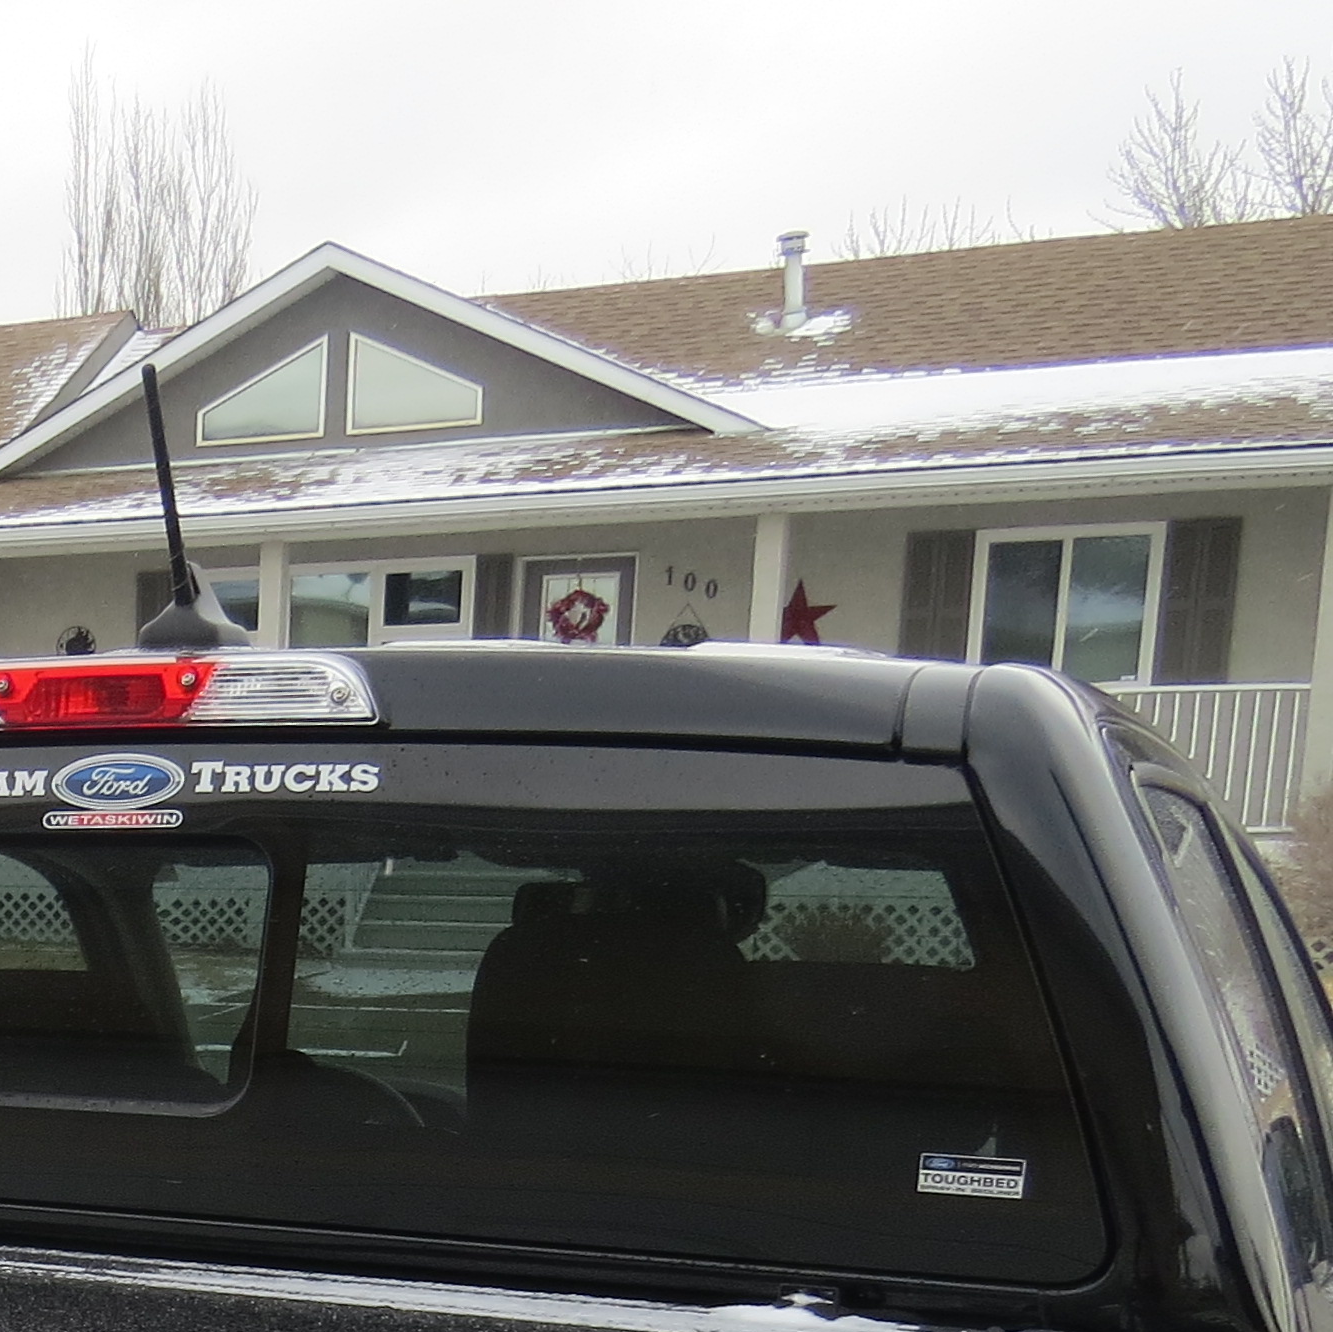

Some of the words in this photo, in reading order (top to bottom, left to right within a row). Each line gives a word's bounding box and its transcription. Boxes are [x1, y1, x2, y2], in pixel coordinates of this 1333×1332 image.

[665, 566, 718, 599] 100
[83, 766, 149, 797] Ford
[191, 760, 379, 793] TRUCKS
[50, 813, 178, 826] WETASKIWIN
[920, 1172, 1019, 1189] TOUGHBED
